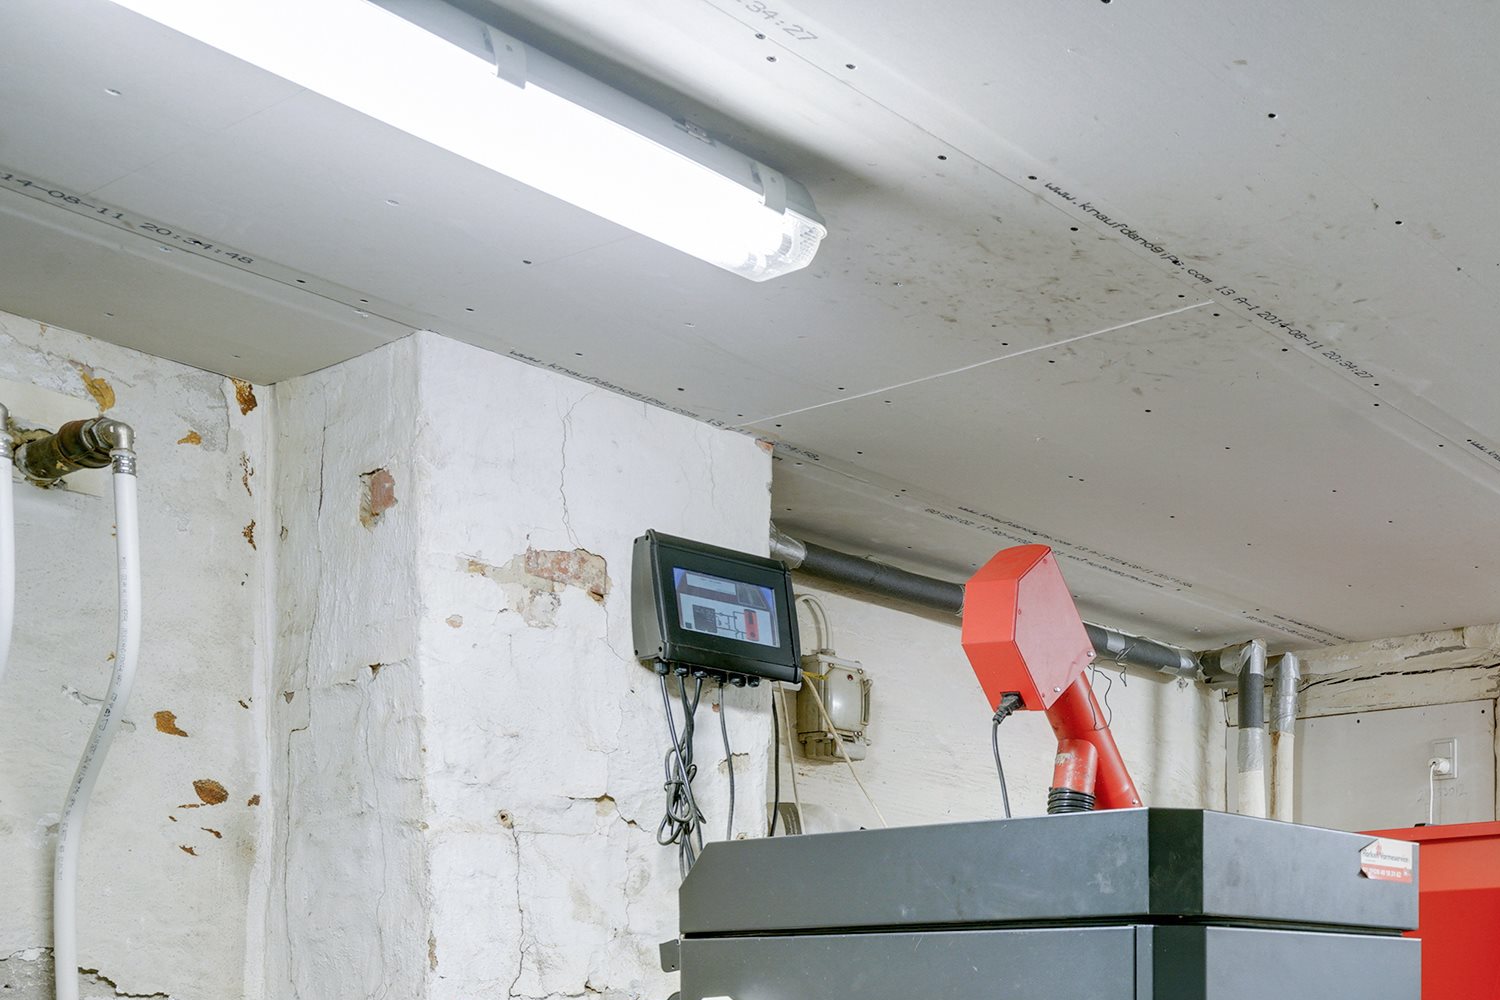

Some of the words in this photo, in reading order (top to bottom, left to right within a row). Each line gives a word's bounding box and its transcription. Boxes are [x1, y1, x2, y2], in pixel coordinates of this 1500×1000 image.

[738, 0, 818, 40] 34:27
[0, 171, 123, 221] 14-08-11
[1215, 286, 1236, 296] 13
